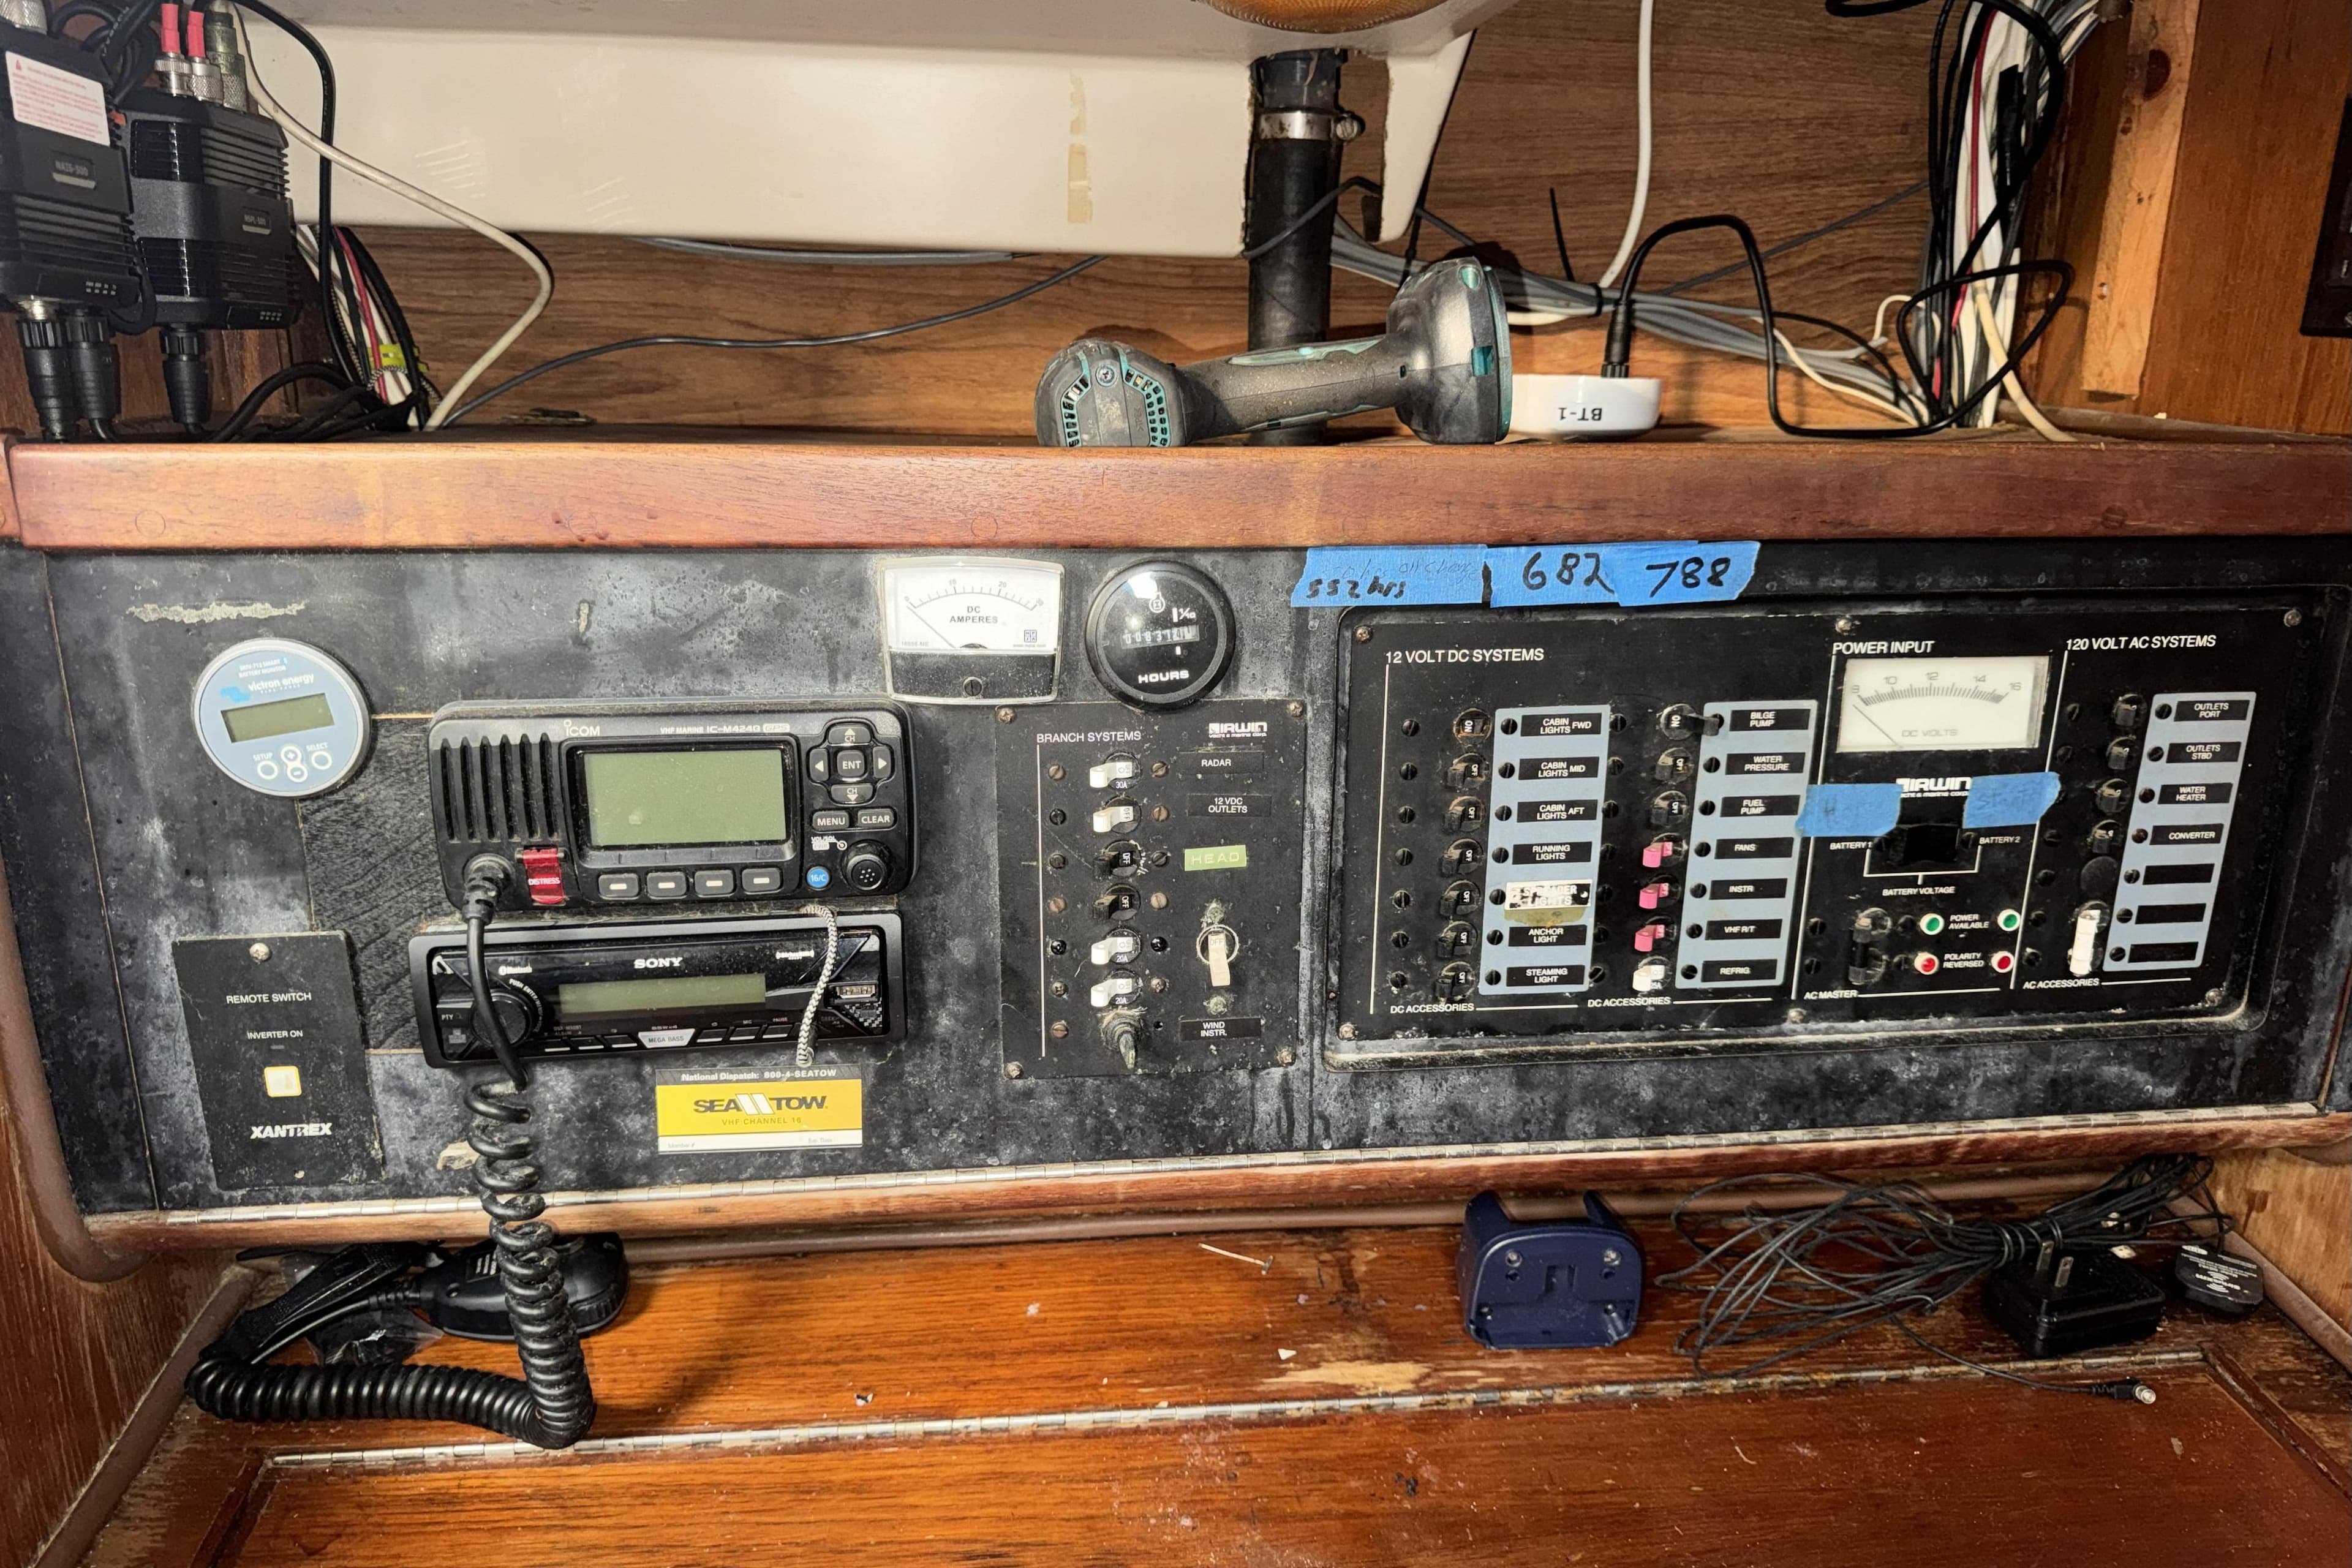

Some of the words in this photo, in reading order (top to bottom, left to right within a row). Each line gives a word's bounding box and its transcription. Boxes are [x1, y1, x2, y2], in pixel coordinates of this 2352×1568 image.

[1558, 407, 1602, 421] BT-1
[1522, 551, 1616, 594] 682
[1646, 556, 1730, 597] 788
[1306, 578, 1361, 600] 552
[1366, 575, 1406, 599] hrs
[949, 616, 999, 624] AMPERES
[2065, 639, 2089, 650] 120
[2092, 637, 2129, 650] VOLT
[2129, 636, 2150, 649] AC
[2151, 635, 2217, 648] SYSTEMS
[1833, 642, 1888, 655] POWER
[1890, 641, 1935, 654] INPUT
[1385, 651, 1403, 664] 12
[1405, 650, 1446, 663] VOLT
[1447, 649, 1470, 662] DC
[1472, 647, 1545, 662] SYSTEMS
[1138, 670, 1189, 684] HOURS
[1883, 676, 1898, 685] 10
[1925, 671, 1939, 681] 12
[1973, 675, 1987, 684] 14
[248, 679, 281, 692] victron
[282, 673, 314, 685] energy
[2009, 682, 2022, 691] 16
[2193, 703, 2230, 711] OUTLETS
[1542, 718, 1569, 726] CABIN
[1572, 721, 1592, 729] FWD
[1671, 715, 1681, 728] ON
[706, 725, 761, 733] IC-M424G
[1219, 722, 1268, 733] IRWIN
[1464, 720, 1474, 733] ON
[1540, 726, 1571, 734] LIGHTS
[1921, 728, 1958, 737] VOLTS
[1036, 733, 1085, 744] BRANCH
[1087, 731, 1142, 742] SYSTEMS
[306, 742, 328, 752] SELECT
[253, 752, 273, 761] SETUP
[842, 760, 861, 769] ENT
[1569, 764, 1586, 773] MID
[1744, 763, 1789, 772] PRESSURE
[1538, 769, 1569, 778] LIGHTS
[1909, 777, 1972, 791] IRWIN
[2176, 793, 2206, 802] HEATER
[1208, 805, 1248, 814] OUTLETS
[1539, 804, 1566, 813] CABIN
[1567, 807, 1585, 815] AFT
[1741, 807, 1766, 815] PUMP
[861, 815, 891, 824] CLEAR
[1537, 812, 1567, 820] LIGHTS
[2168, 831, 2215, 840] CONVERTER
[1978, 836, 2015, 845] BATTERY
[1830, 841, 1868, 850] BATTERY
[1122, 852, 1131, 865] OFF
[1191, 851, 1240, 865] HEAD
[529, 876, 561, 887] DISTRESS
[1882, 888, 1918, 897] BATTERY
[1918, 886, 1956, 895] VOLTAGE
[1948, 921, 1990, 930] AVAILABLE
[1528, 927, 1564, 936] ANCHOR
[1210, 938, 1224, 947] OFF
[1944, 952, 1981, 961] POLARITY
[633, 957, 684, 970] SONY
[1943, 960, 1985, 968] REVERSED
[509, 978, 524, 989] PUSH
[2022, 981, 2037, 989] AC
[2037, 978, 2100, 989] ACCESSORIES
[226, 993, 270, 1005] REMOTE
[272, 992, 312, 1003] SWITCH
[1819, 990, 1857, 999] MASTER
[1588, 999, 1603, 1008] DC
[1603, 997, 1672, 1007] ACCESSORIES
[1390, 1006, 1405, 1014] DC
[1405, 1003, 1474, 1013] ACCESSORIES
[247, 1030, 288, 1040] INVERTER
[290, 1030, 303, 1038] ON
[681, 1072, 718, 1082] National
[720, 1072, 760, 1082] Dispatch:
[764, 1069, 837, 1079] 800-4-SEATOW
[693, 1098, 742, 1114] SEA
[250, 1122, 333, 1139] XANTREX
